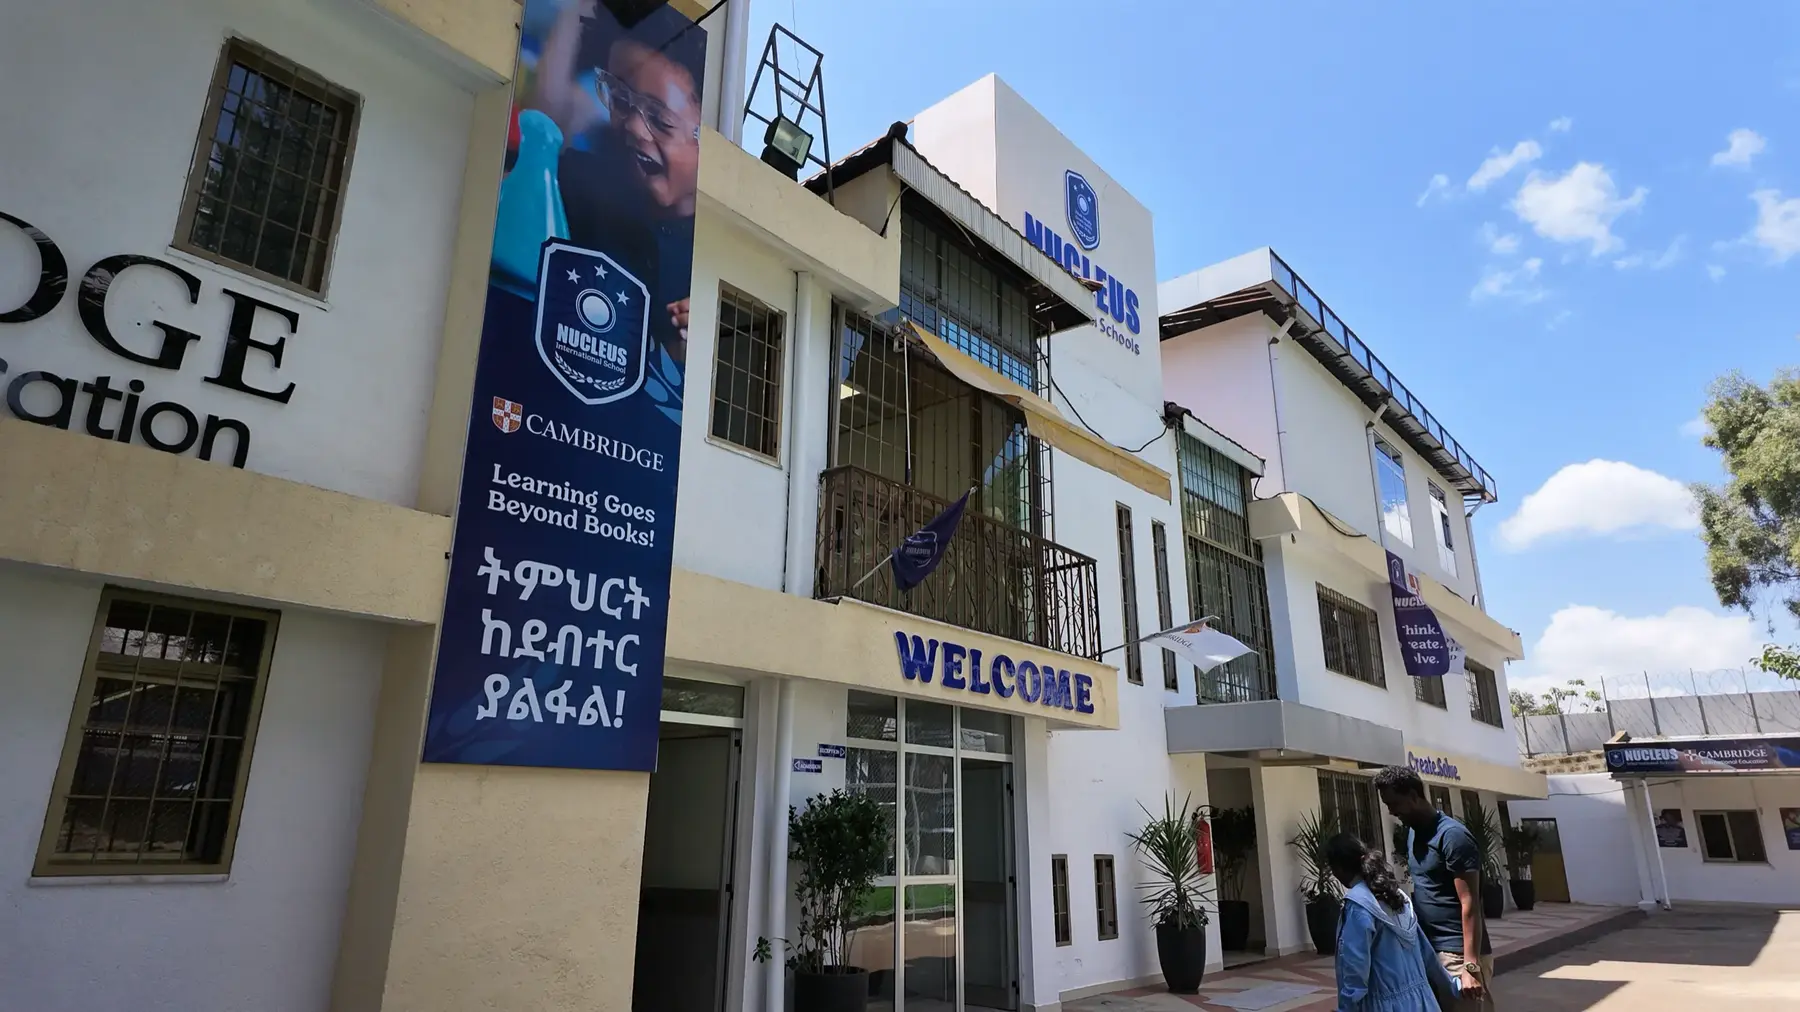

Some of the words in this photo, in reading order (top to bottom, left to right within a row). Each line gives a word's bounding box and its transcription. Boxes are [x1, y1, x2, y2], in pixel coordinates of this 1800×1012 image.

[555, 341, 602, 365] International
[603, 360, 626, 374] School
[557, 323, 627, 366] NUCLEUS
[1100, 317, 1140, 355] Schools
[0, 357, 250, 469] ation
[526, 413, 664, 472] CAMBRIDGE
[487, 490, 578, 530] Beyond
[584, 514, 655, 547] Books!
[492, 463, 598, 514] Learning
[604, 494, 655, 522] Goes
[477, 546, 650, 620] ትምህርት
[481, 608, 640, 677] ከደብተር
[1402, 624, 1440, 635] hink.
[1408, 639, 1443, 649] eate.
[894, 631, 1095, 714] WELCOME
[476, 673, 626, 728] ያልፋል!
[1625, 748, 1678, 761] NUCLEUS
[1698, 749, 1768, 758] CAMBRIDGE
